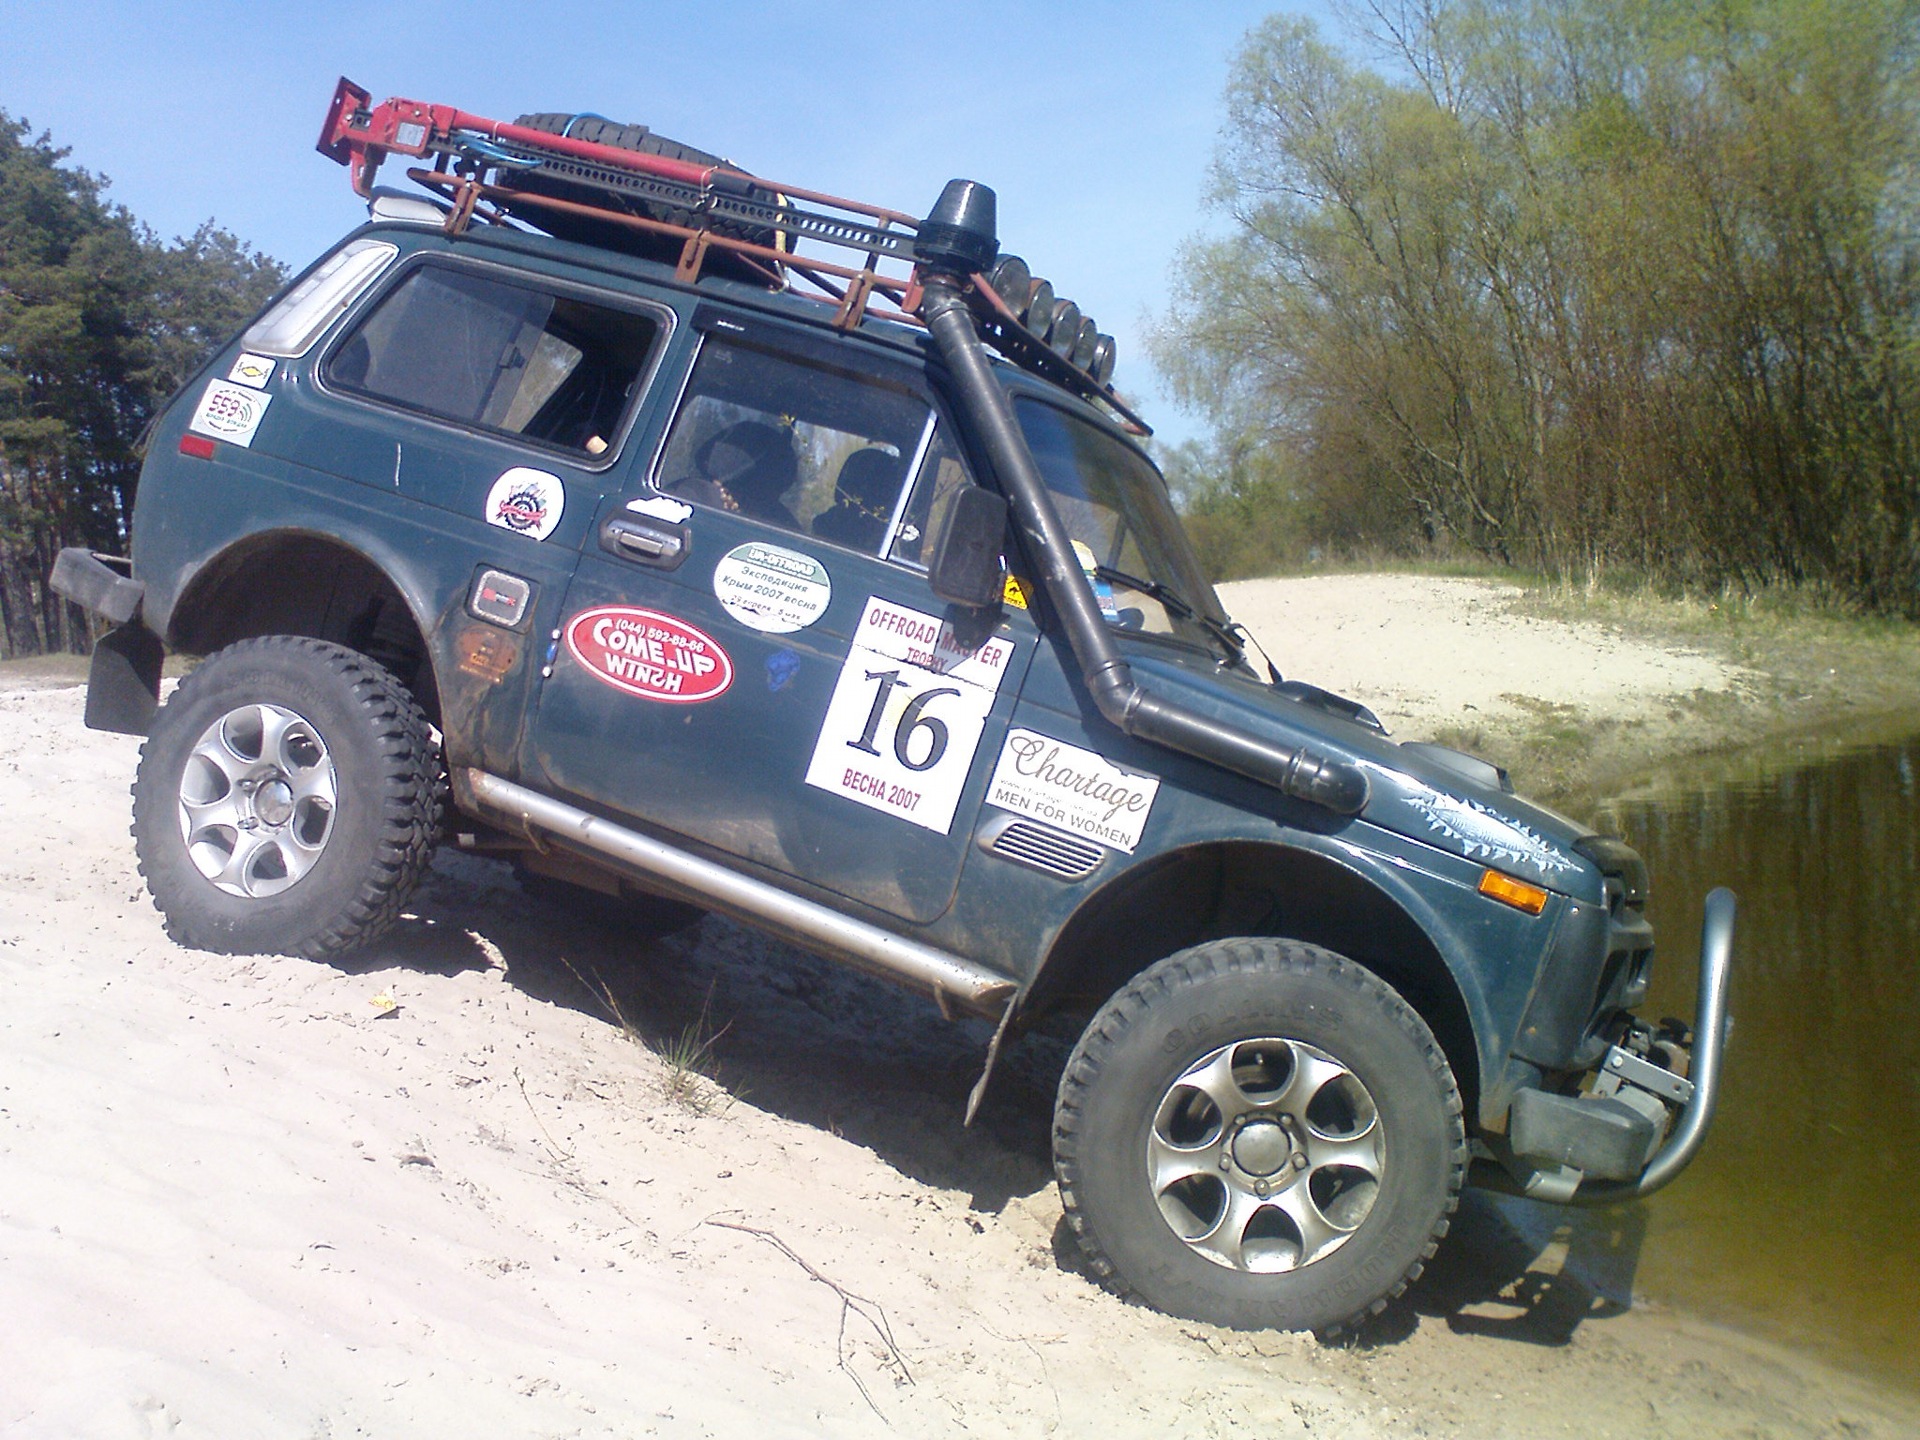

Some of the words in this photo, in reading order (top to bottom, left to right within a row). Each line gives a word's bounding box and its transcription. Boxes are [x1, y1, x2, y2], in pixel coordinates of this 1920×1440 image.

[754, 584, 785, 601] 2007
[615, 618, 646, 638] (044)
[868, 607, 937, 645] OFFROAD
[906, 646, 949, 672] TROPHY
[846, 669, 962, 772] 16
[1010, 735, 1148, 823] Chartage
[887, 785, 922, 812] 2007
[995, 787, 1031, 810] MEN
[1034, 801, 1066, 823] FOR
[1070, 814, 1133, 847] WOMEN
